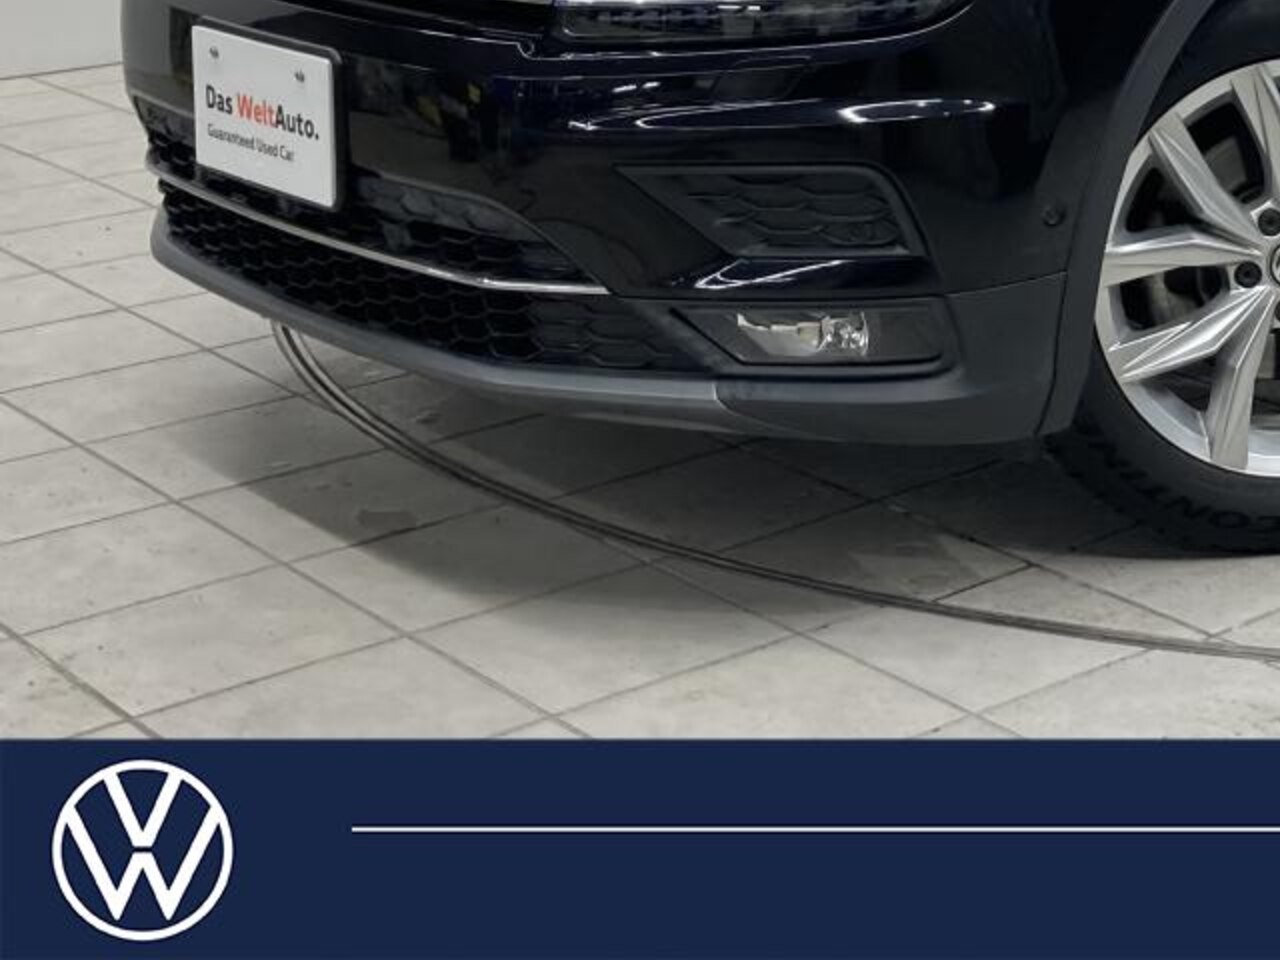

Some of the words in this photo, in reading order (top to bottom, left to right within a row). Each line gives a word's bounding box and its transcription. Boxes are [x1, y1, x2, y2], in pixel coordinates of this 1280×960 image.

[206, 84, 233, 115] Das
[236, 93, 319, 140] WeltAuto.
[207, 123, 255, 152] Guaranteed
[256, 139, 278, 158] Used
[279, 145, 294, 161] Car
